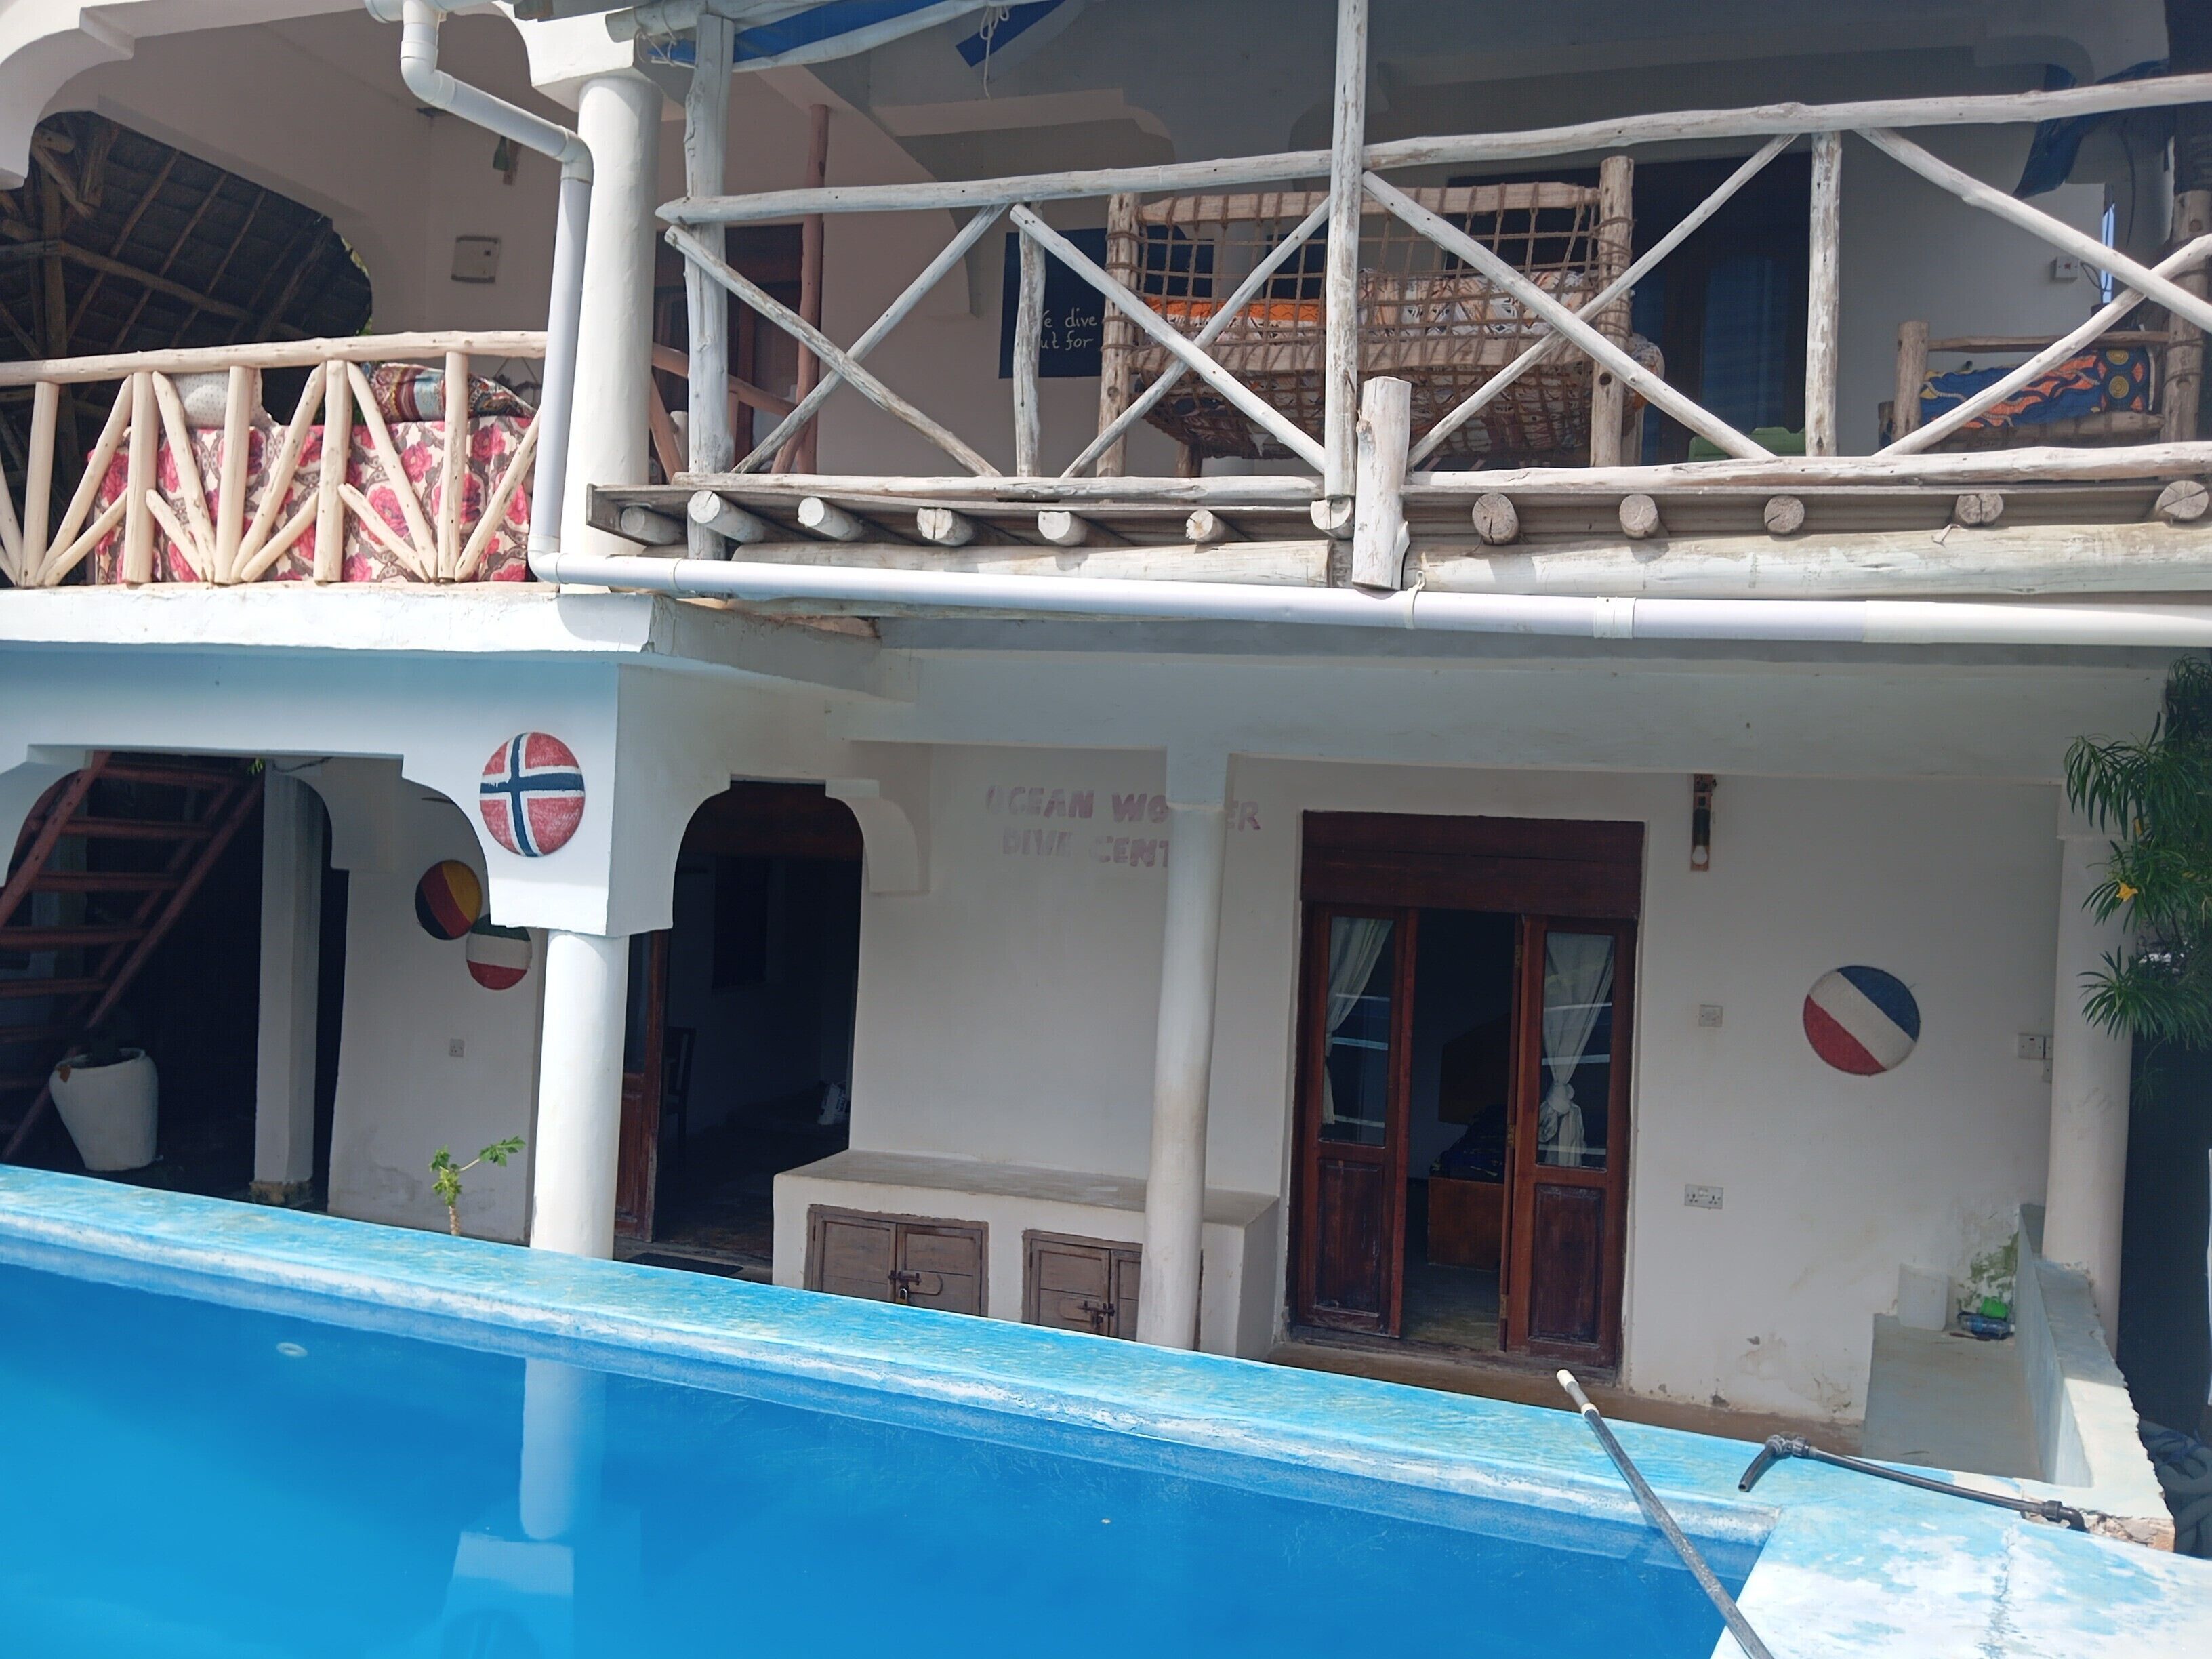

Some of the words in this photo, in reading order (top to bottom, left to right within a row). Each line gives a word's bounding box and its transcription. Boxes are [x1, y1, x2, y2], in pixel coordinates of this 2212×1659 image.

[1042, 309, 1053, 328] e
[1065, 307, 1098, 328] dive
[1040, 331, 1059, 349] ut
[1065, 330, 1094, 351] for
[985, 785, 1095, 819] OCEAN
[1111, 792, 1261, 832] WOER
[1002, 828, 1071, 857] DIVE
[1088, 835, 1170, 868] CENT
